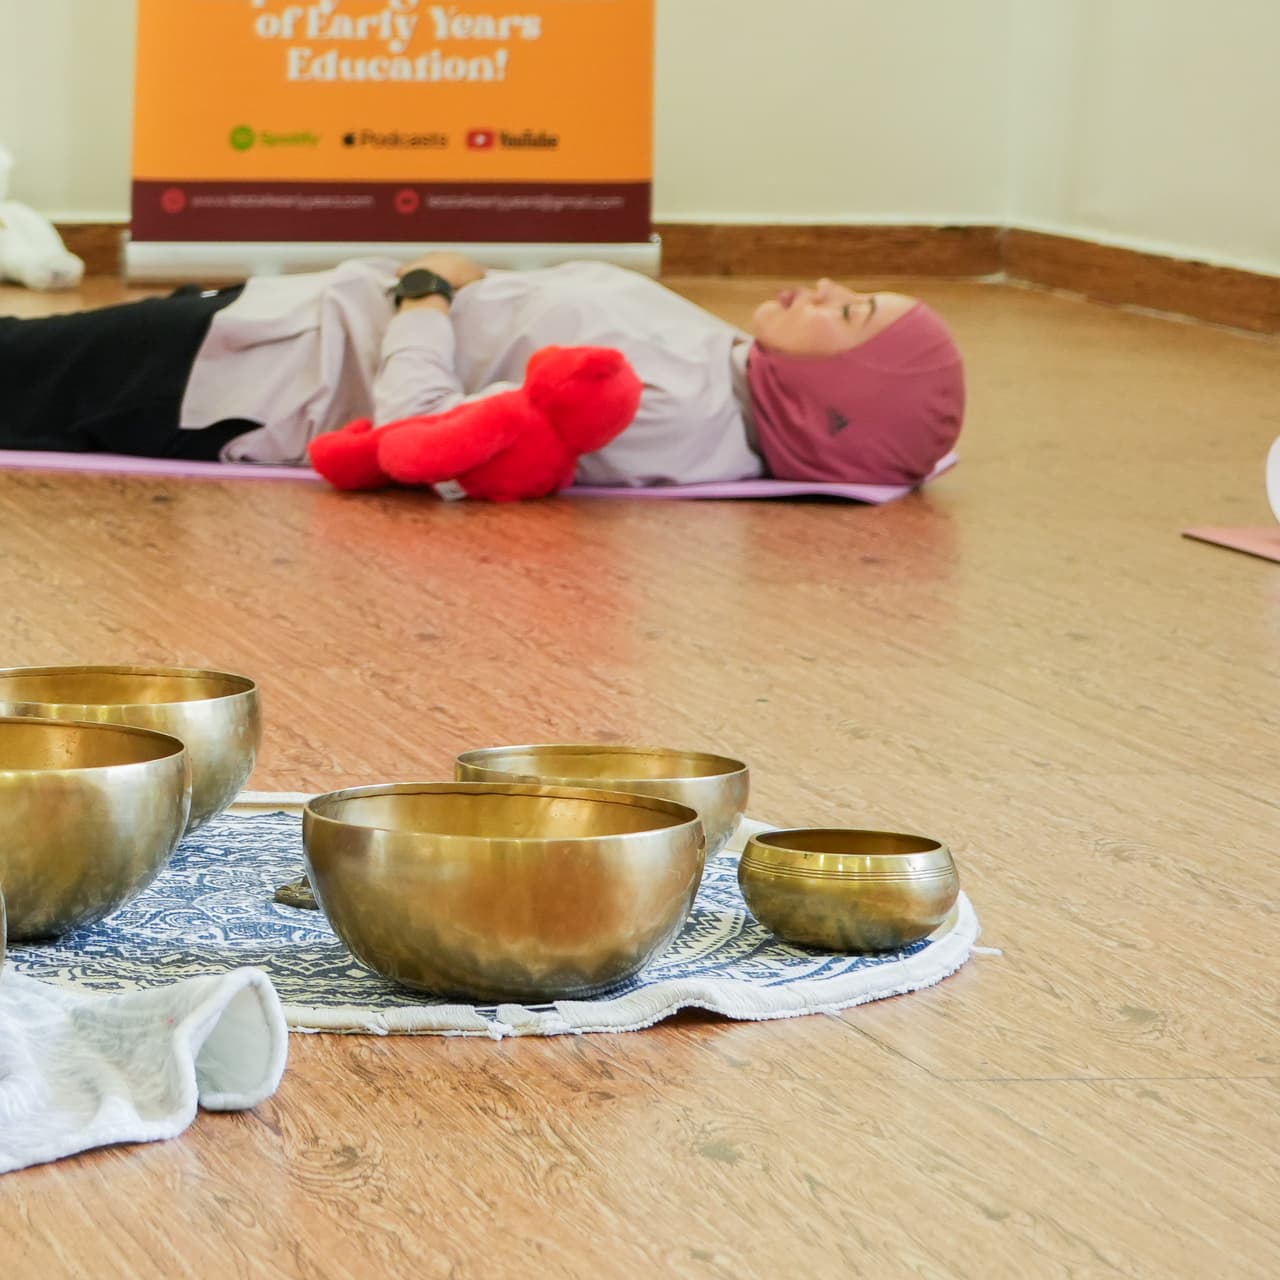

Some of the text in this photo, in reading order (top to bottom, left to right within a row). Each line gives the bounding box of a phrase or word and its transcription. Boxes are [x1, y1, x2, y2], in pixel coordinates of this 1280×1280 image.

[255, 6, 542, 53] of Early Years
[287, 47, 508, 82] Education!
[259, 130, 318, 148] Spotify
[360, 129, 447, 148] Podcasts
[499, 130, 558, 150] YouTube
